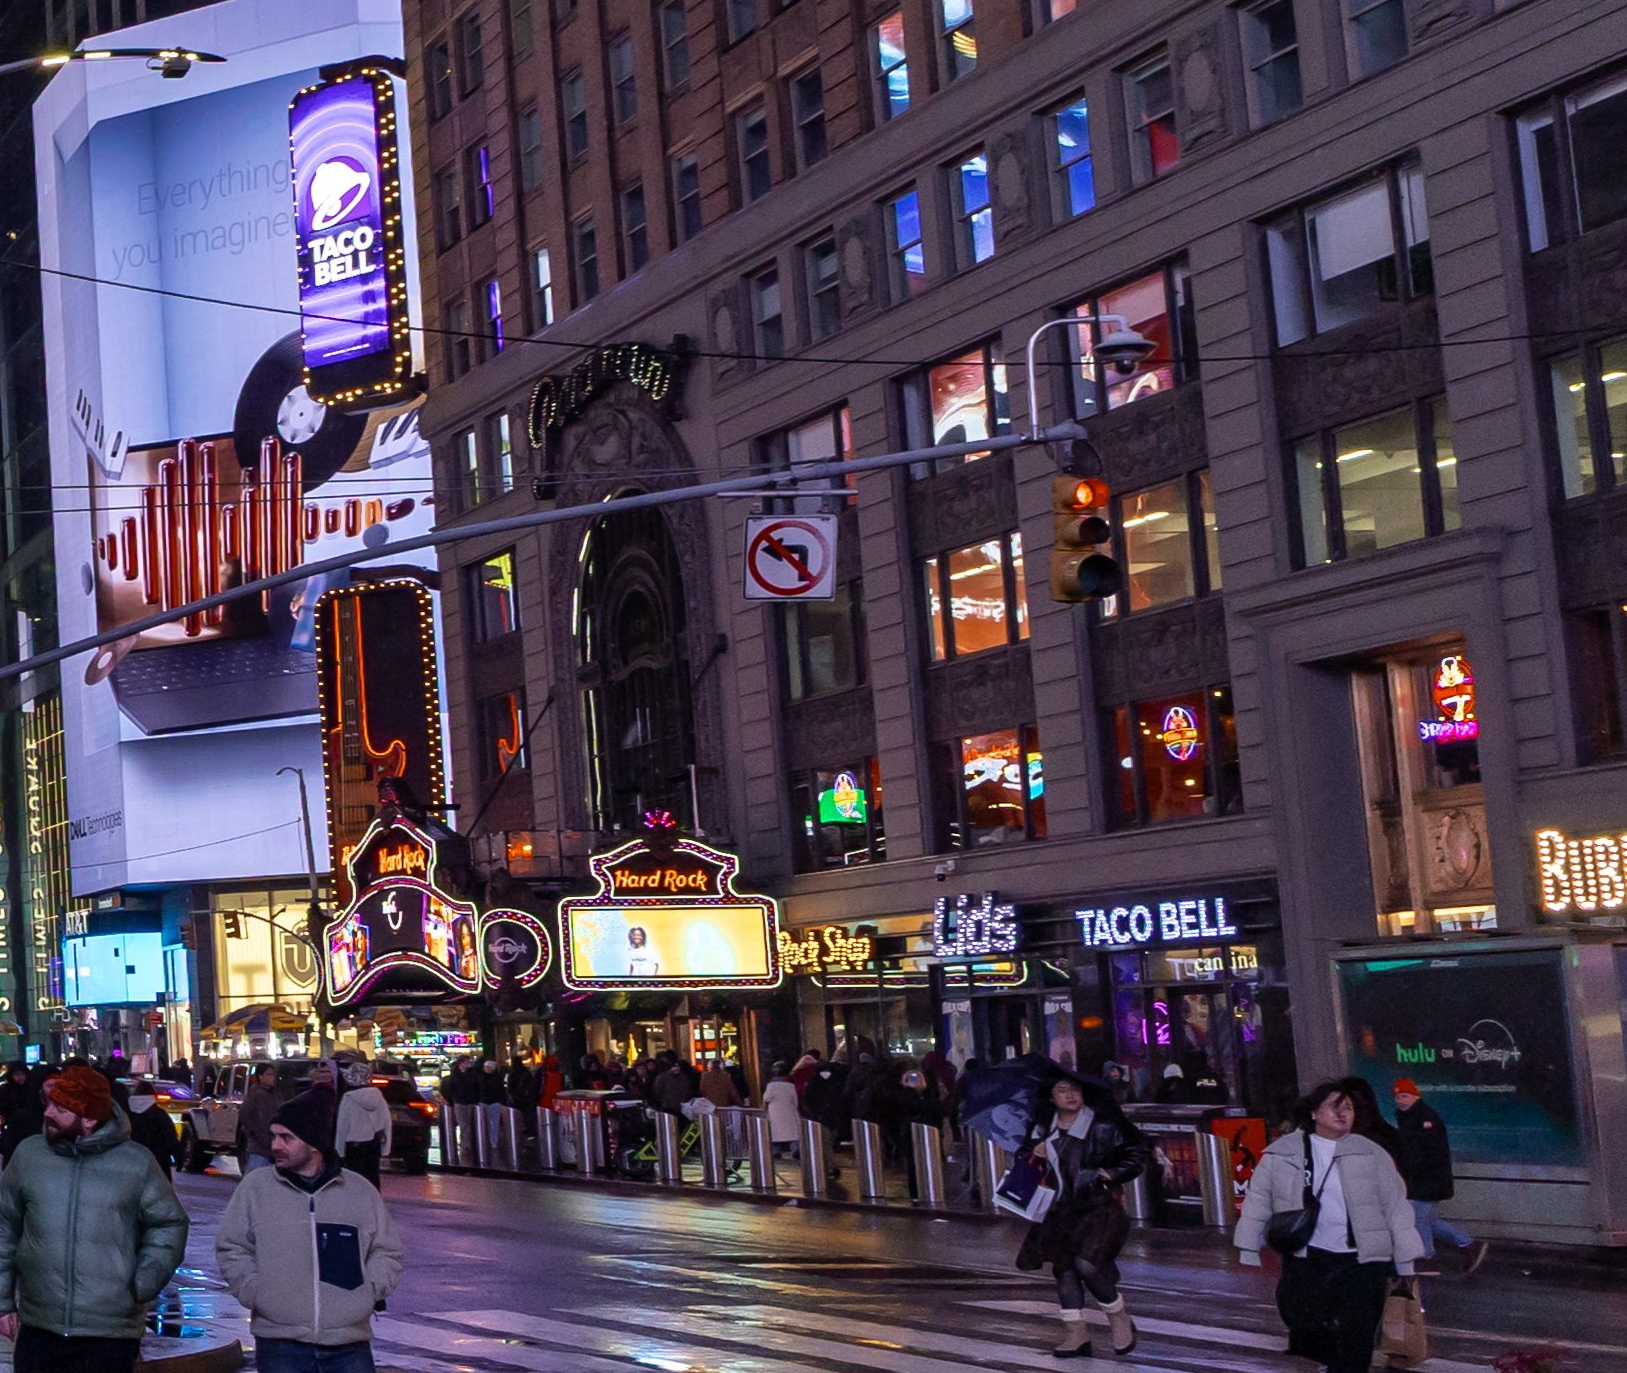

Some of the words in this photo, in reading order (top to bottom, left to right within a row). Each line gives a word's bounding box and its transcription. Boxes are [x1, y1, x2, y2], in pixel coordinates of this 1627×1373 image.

[136, 157, 292, 216] Everything
[112, 240, 163, 280] you
[308, 225, 374, 264] TACO
[314, 250, 376, 287] BELL
[378, 846, 403, 875] Hard
[403, 843, 426, 875] Rock
[1536, 830, 1627, 912] BUB
[614, 870, 661, 890] Hard
[664, 870, 709, 892] Rock
[65, 911, 89, 937] AT&T
[933, 891, 1017, 957] Lids
[1075, 905, 1151, 947] TACO
[1160, 897, 1236, 941] BELL
[776, 929, 819, 975] Rock
[823, 926, 870, 972] Shop
[1193, 946, 1259, 972] canina
[1396, 1042, 1436, 1063] hulu
